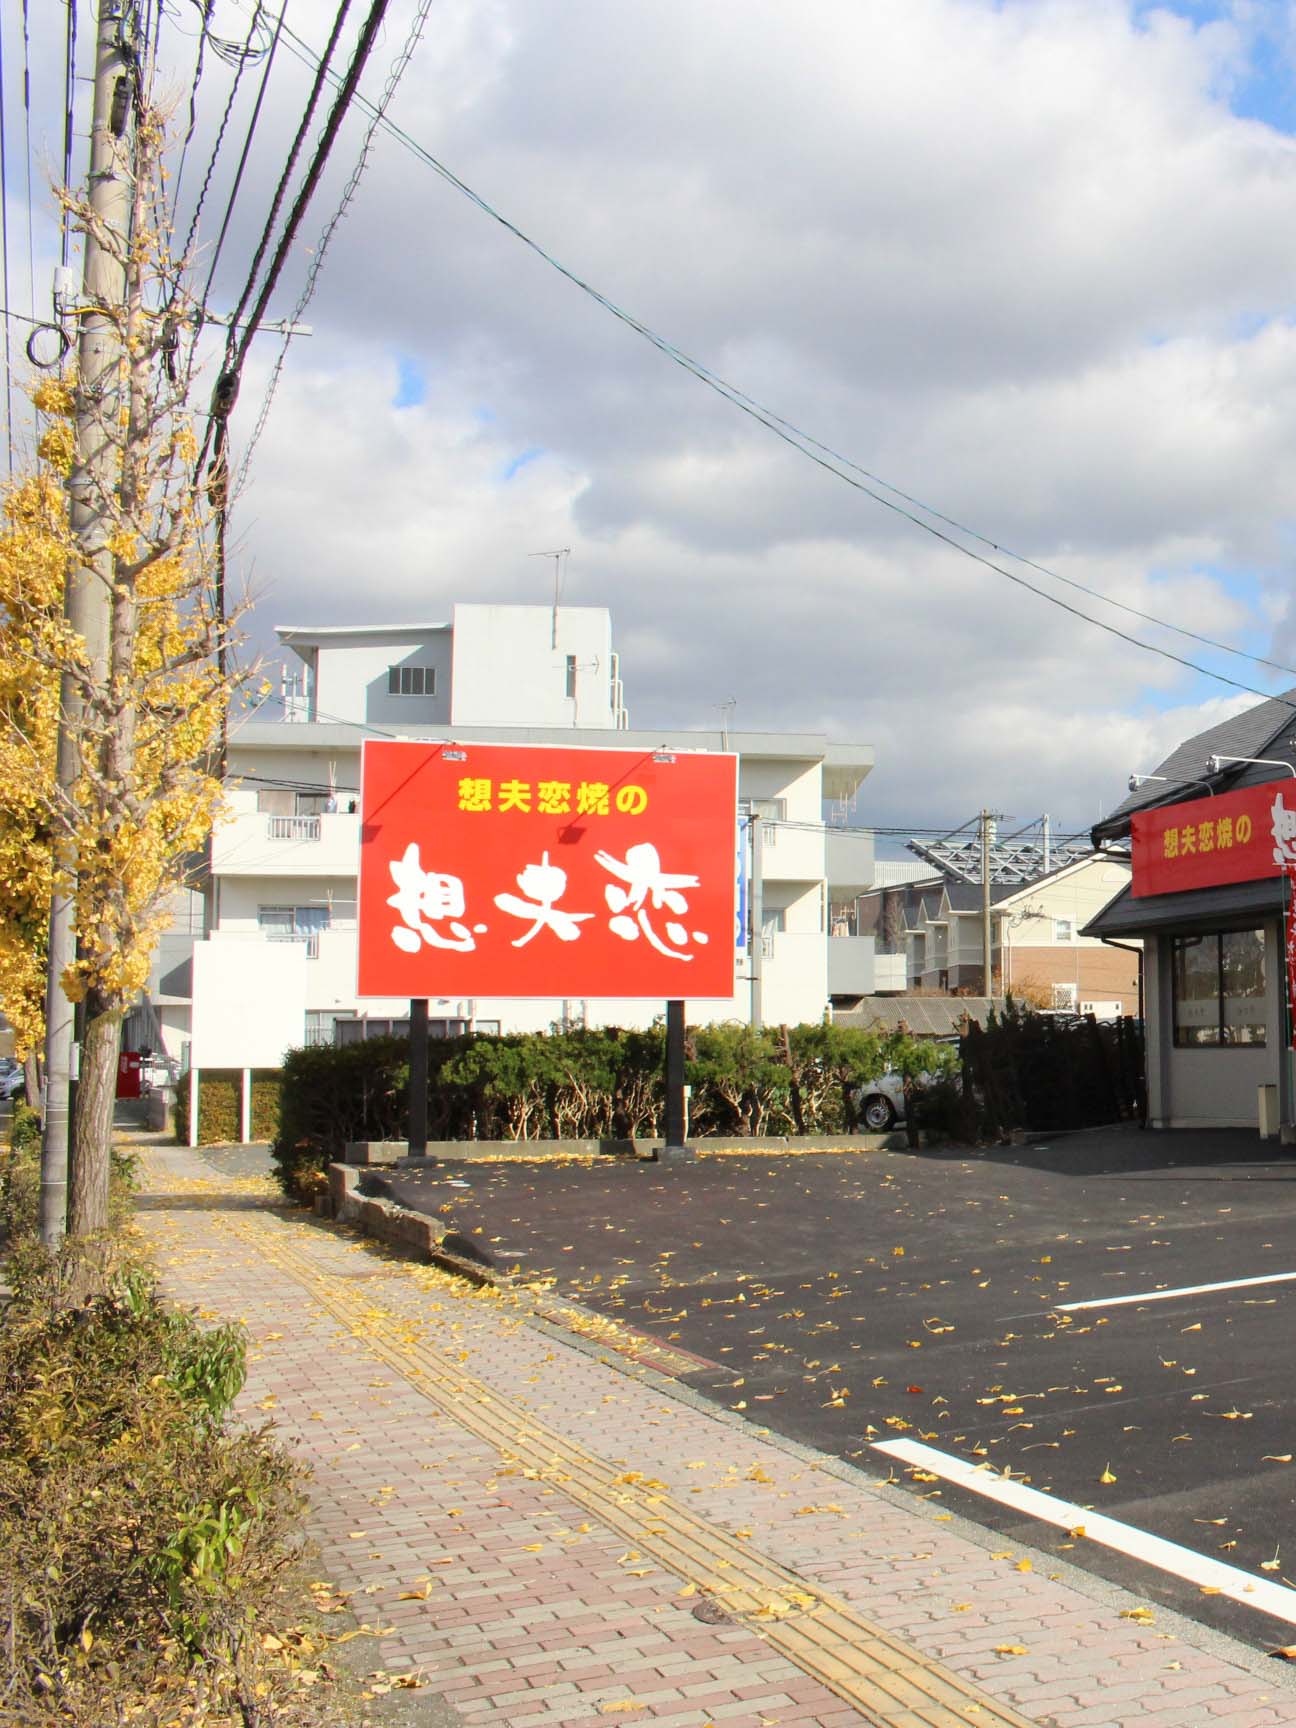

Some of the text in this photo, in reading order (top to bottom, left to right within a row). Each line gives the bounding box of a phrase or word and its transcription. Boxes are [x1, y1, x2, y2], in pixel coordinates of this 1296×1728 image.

[458, 778, 649, 816] 想夫恋焼の
[1163, 814, 1252, 859] 想夫恋焼の
[386, 842, 709, 961] 想夫恋
